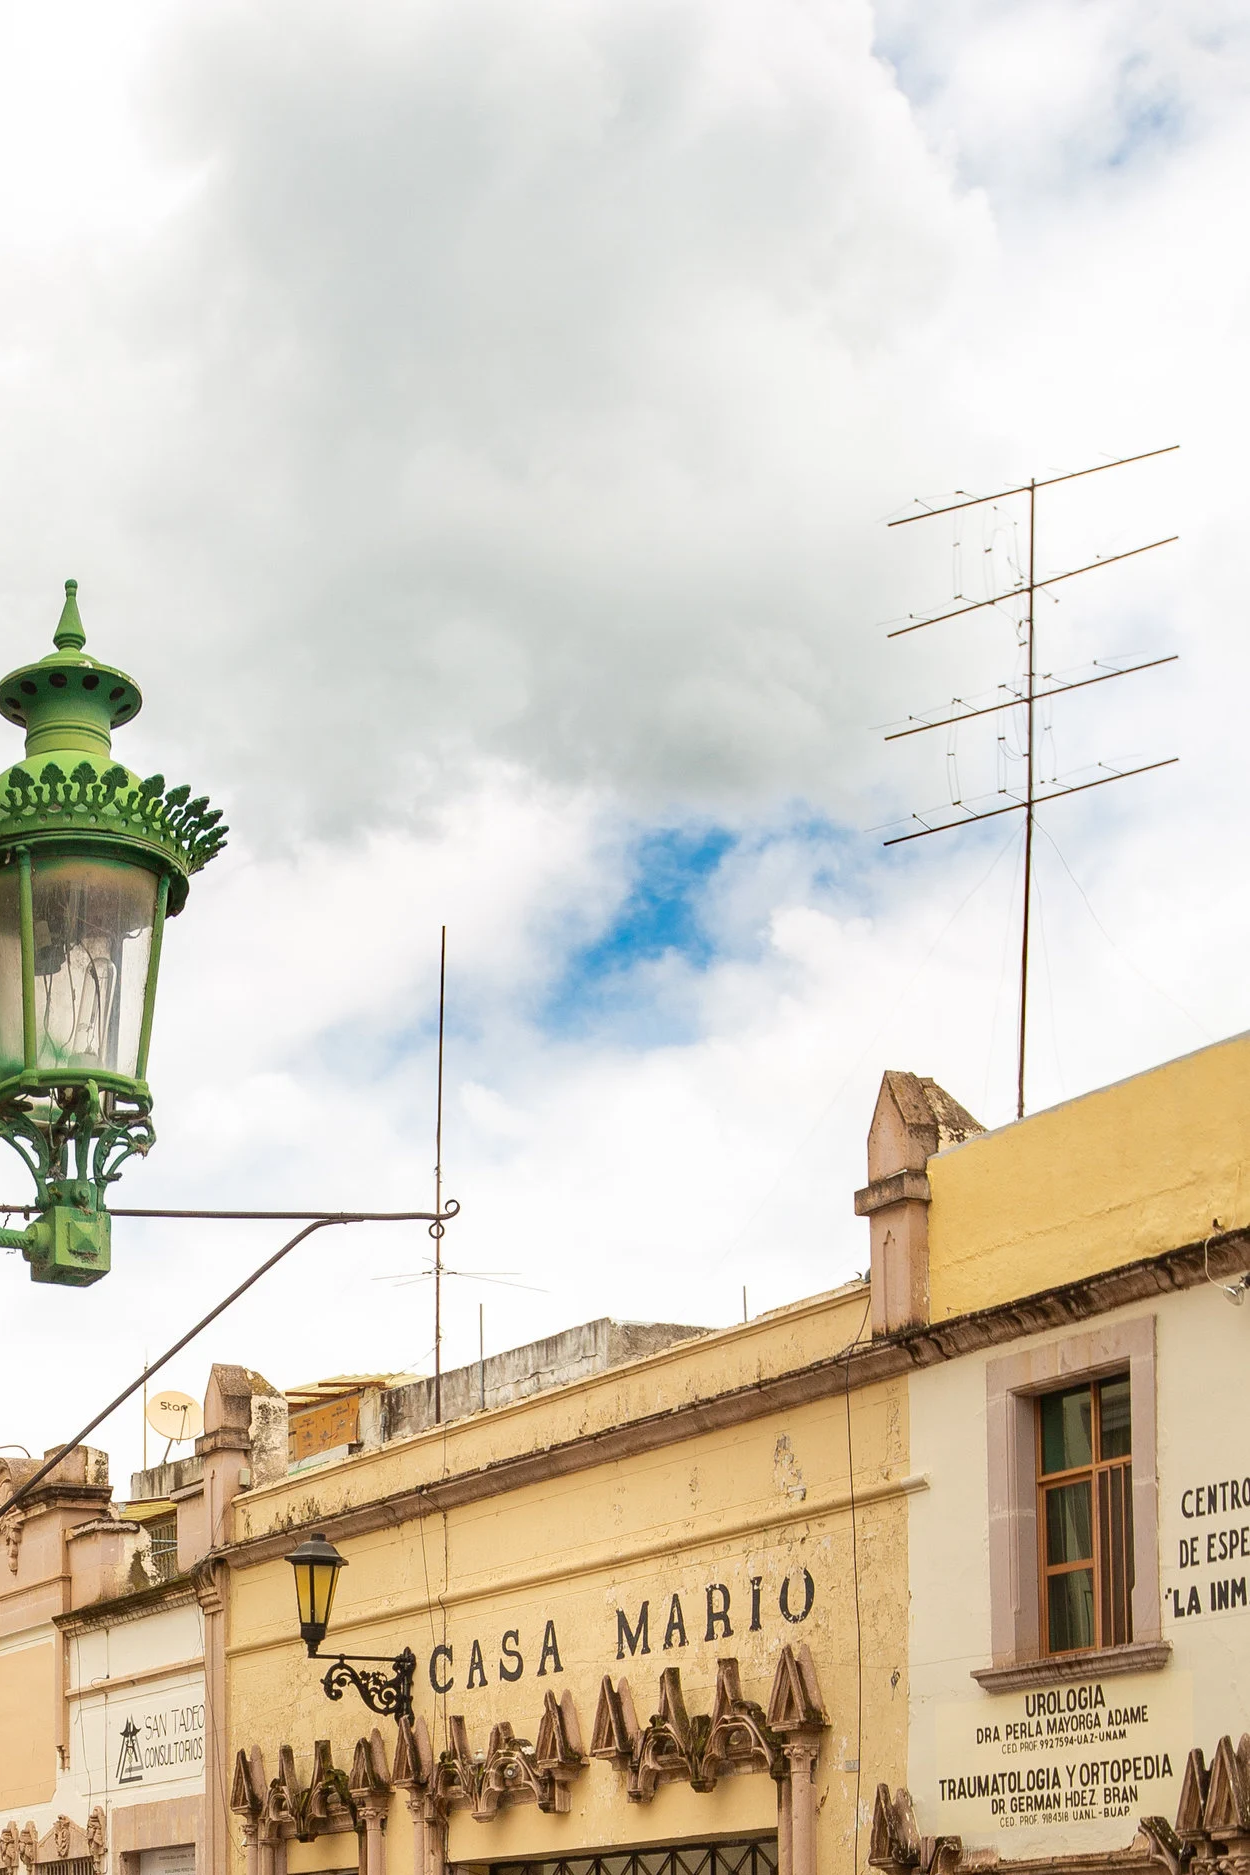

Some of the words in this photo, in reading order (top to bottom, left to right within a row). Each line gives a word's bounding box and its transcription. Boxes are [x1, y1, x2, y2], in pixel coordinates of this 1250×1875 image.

[1181, 1477, 1250, 1519] CENTRO
[1179, 1536, 1200, 1569] DE
[1207, 1526, 1250, 1564] ESPE
[429, 1620, 564, 1694] CASA
[615, 1567, 815, 1660] MARIO
[171, 1704, 205, 1734] TADEO
[1025, 1684, 1106, 1718] UROLOGIA
[1005, 1720, 1043, 1741] PERLA
[1046, 1711, 1101, 1736] MAYORGA
[1107, 1705, 1149, 1727] ADAME
[145, 1737, 203, 1769] CONSULTORIOS
[939, 1767, 1062, 1801] TRAUMATOLOGIA
[1065, 1764, 1077, 1788] Y
[1079, 1753, 1173, 1787] ORTOPEDIA
[1010, 1792, 1061, 1813] GERMAN
[1103, 1785, 1139, 1804] BRAN
